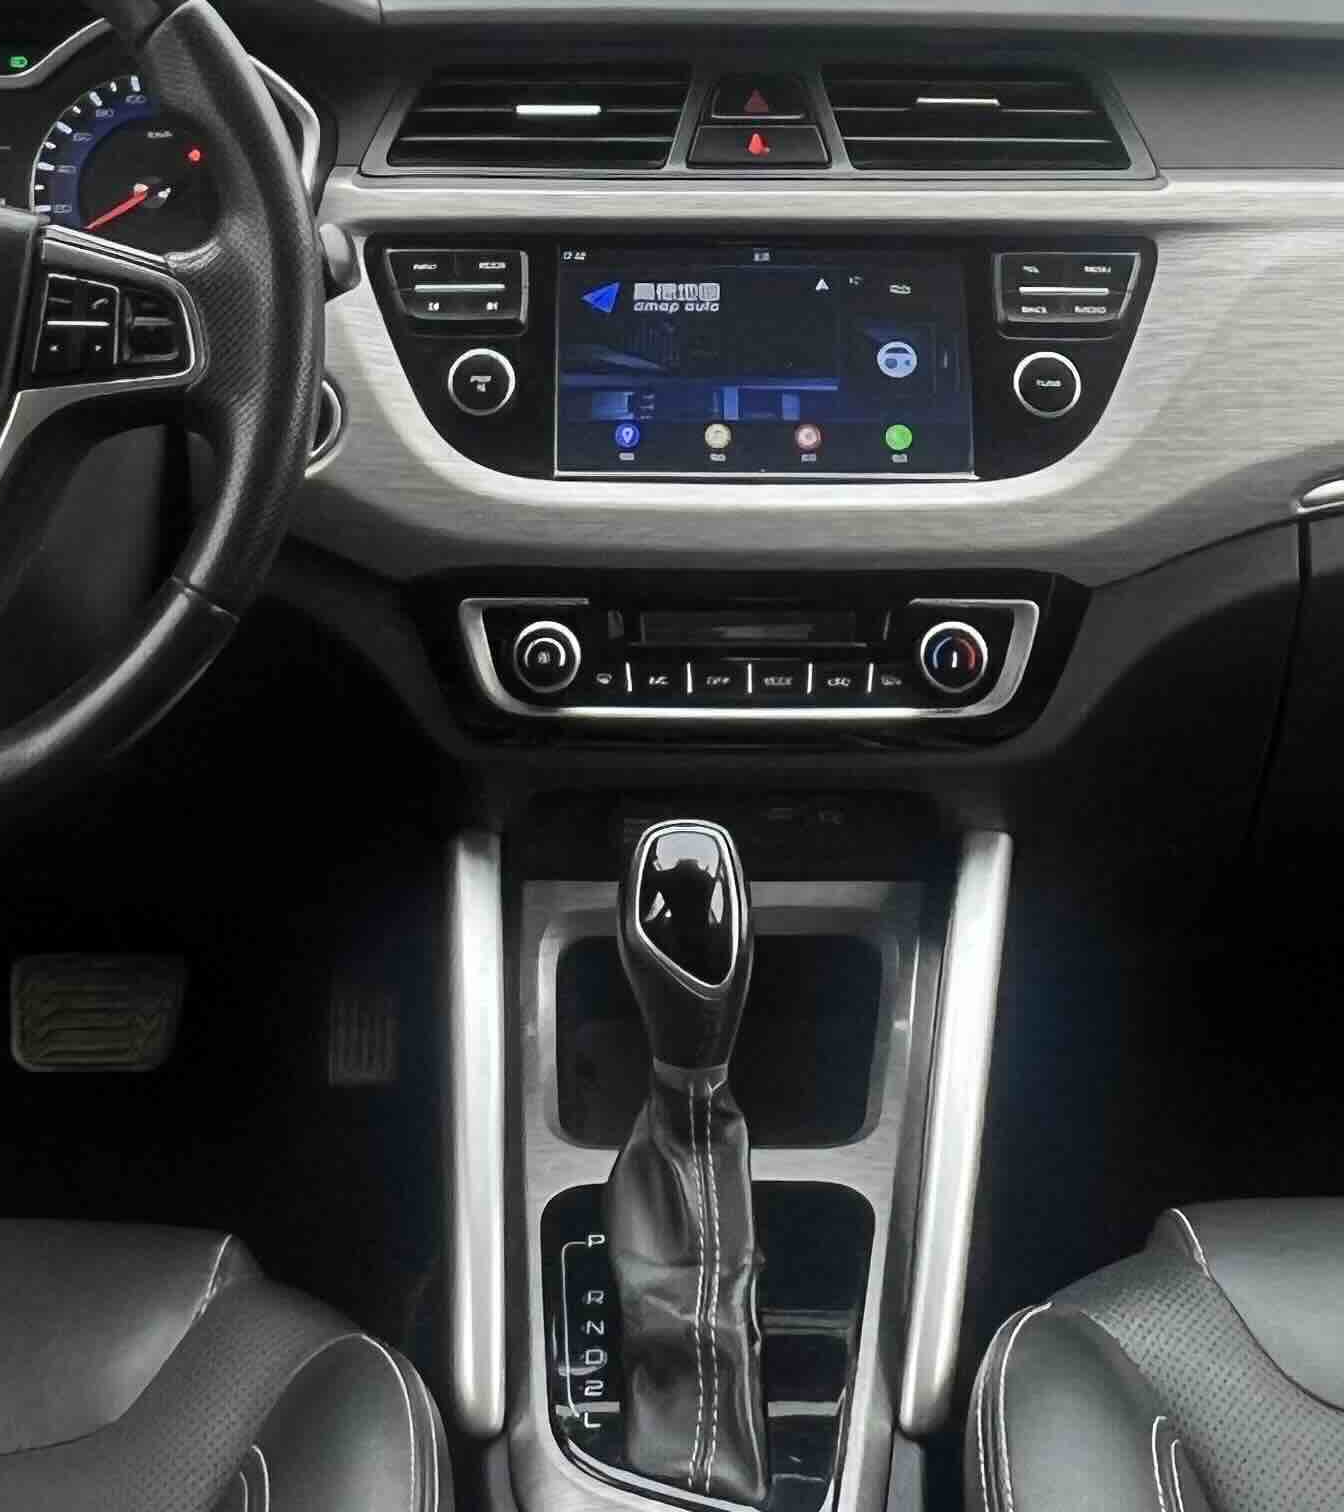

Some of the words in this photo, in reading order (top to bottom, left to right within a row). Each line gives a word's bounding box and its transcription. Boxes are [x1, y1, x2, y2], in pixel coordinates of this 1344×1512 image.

[685, 301, 720, 312] auto
[588, 1235, 605, 1248] P
[586, 1290, 604, 1304] R
[586, 1320, 604, 1335] N
[585, 1349, 603, 1365] D
[584, 1380, 603, 1396] 2
[584, 1412, 601, 1427] L
